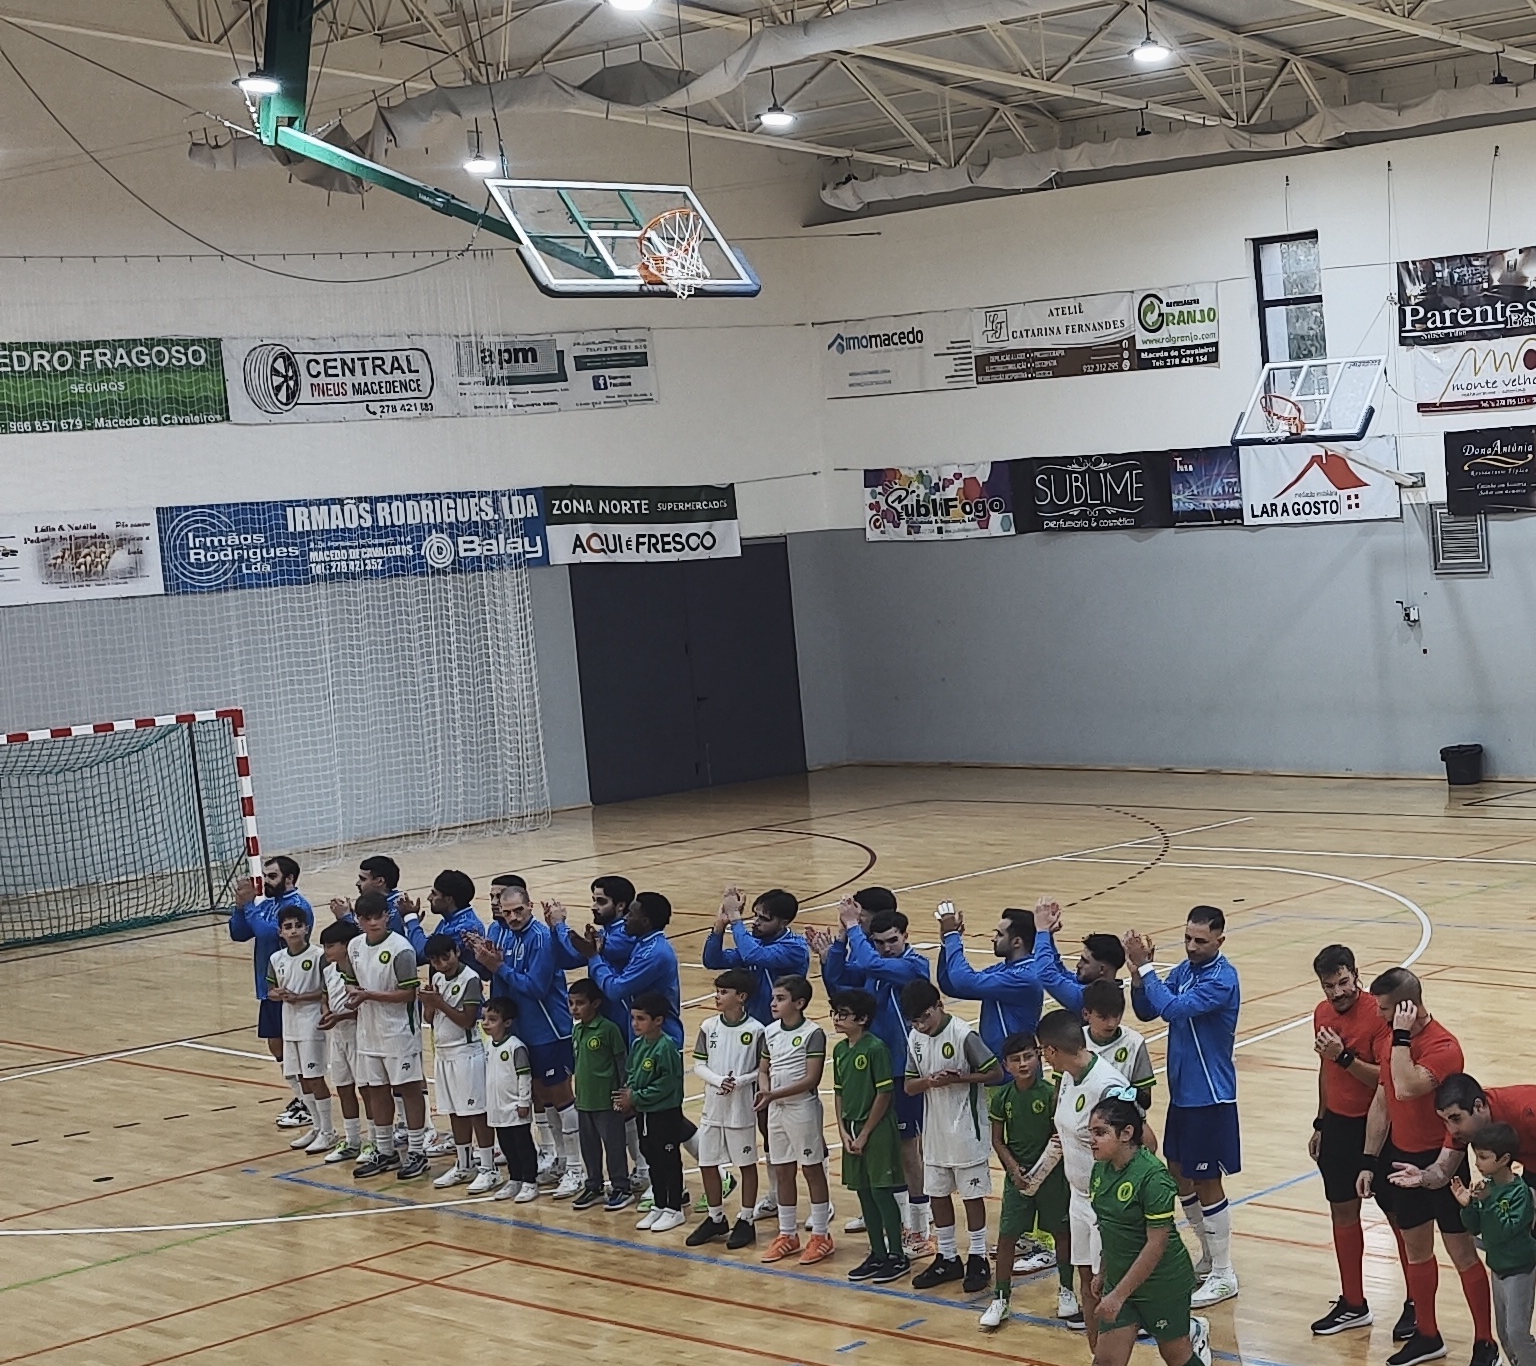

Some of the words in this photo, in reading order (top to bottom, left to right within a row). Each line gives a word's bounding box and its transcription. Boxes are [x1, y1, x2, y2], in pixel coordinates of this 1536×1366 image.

[1011, 325, 1062, 340] CATARINA
[1065, 319, 1126, 335] FERNANDES
[80, 346, 207, 370] FRAGOSO
[306, 355, 420, 378] CENTRAL
[70, 382, 125, 394] SEGUROS
[310, 382, 348, 398] PNEUS
[352, 378, 423, 396] MACEDENCE
[1452, 379, 1498, 392] monte
[94, 416, 140, 428] Macedo
[143, 415, 158, 426] de
[1035, 470, 1145, 504] SUBLIME
[502, 495, 539, 519] LDA
[552, 499, 595, 515] ZONA
[598, 499, 650, 514] NORTE
[188, 532, 265, 548] Irmãos
[457, 534, 543, 559] Balay
[572, 532, 624, 555] AQUI
[635, 531, 717, 554] FRESCO
[190, 546, 299, 563] Rodrigues
[309, 549, 348, 562] MACEDO
[241, 563, 271, 573] Lda
